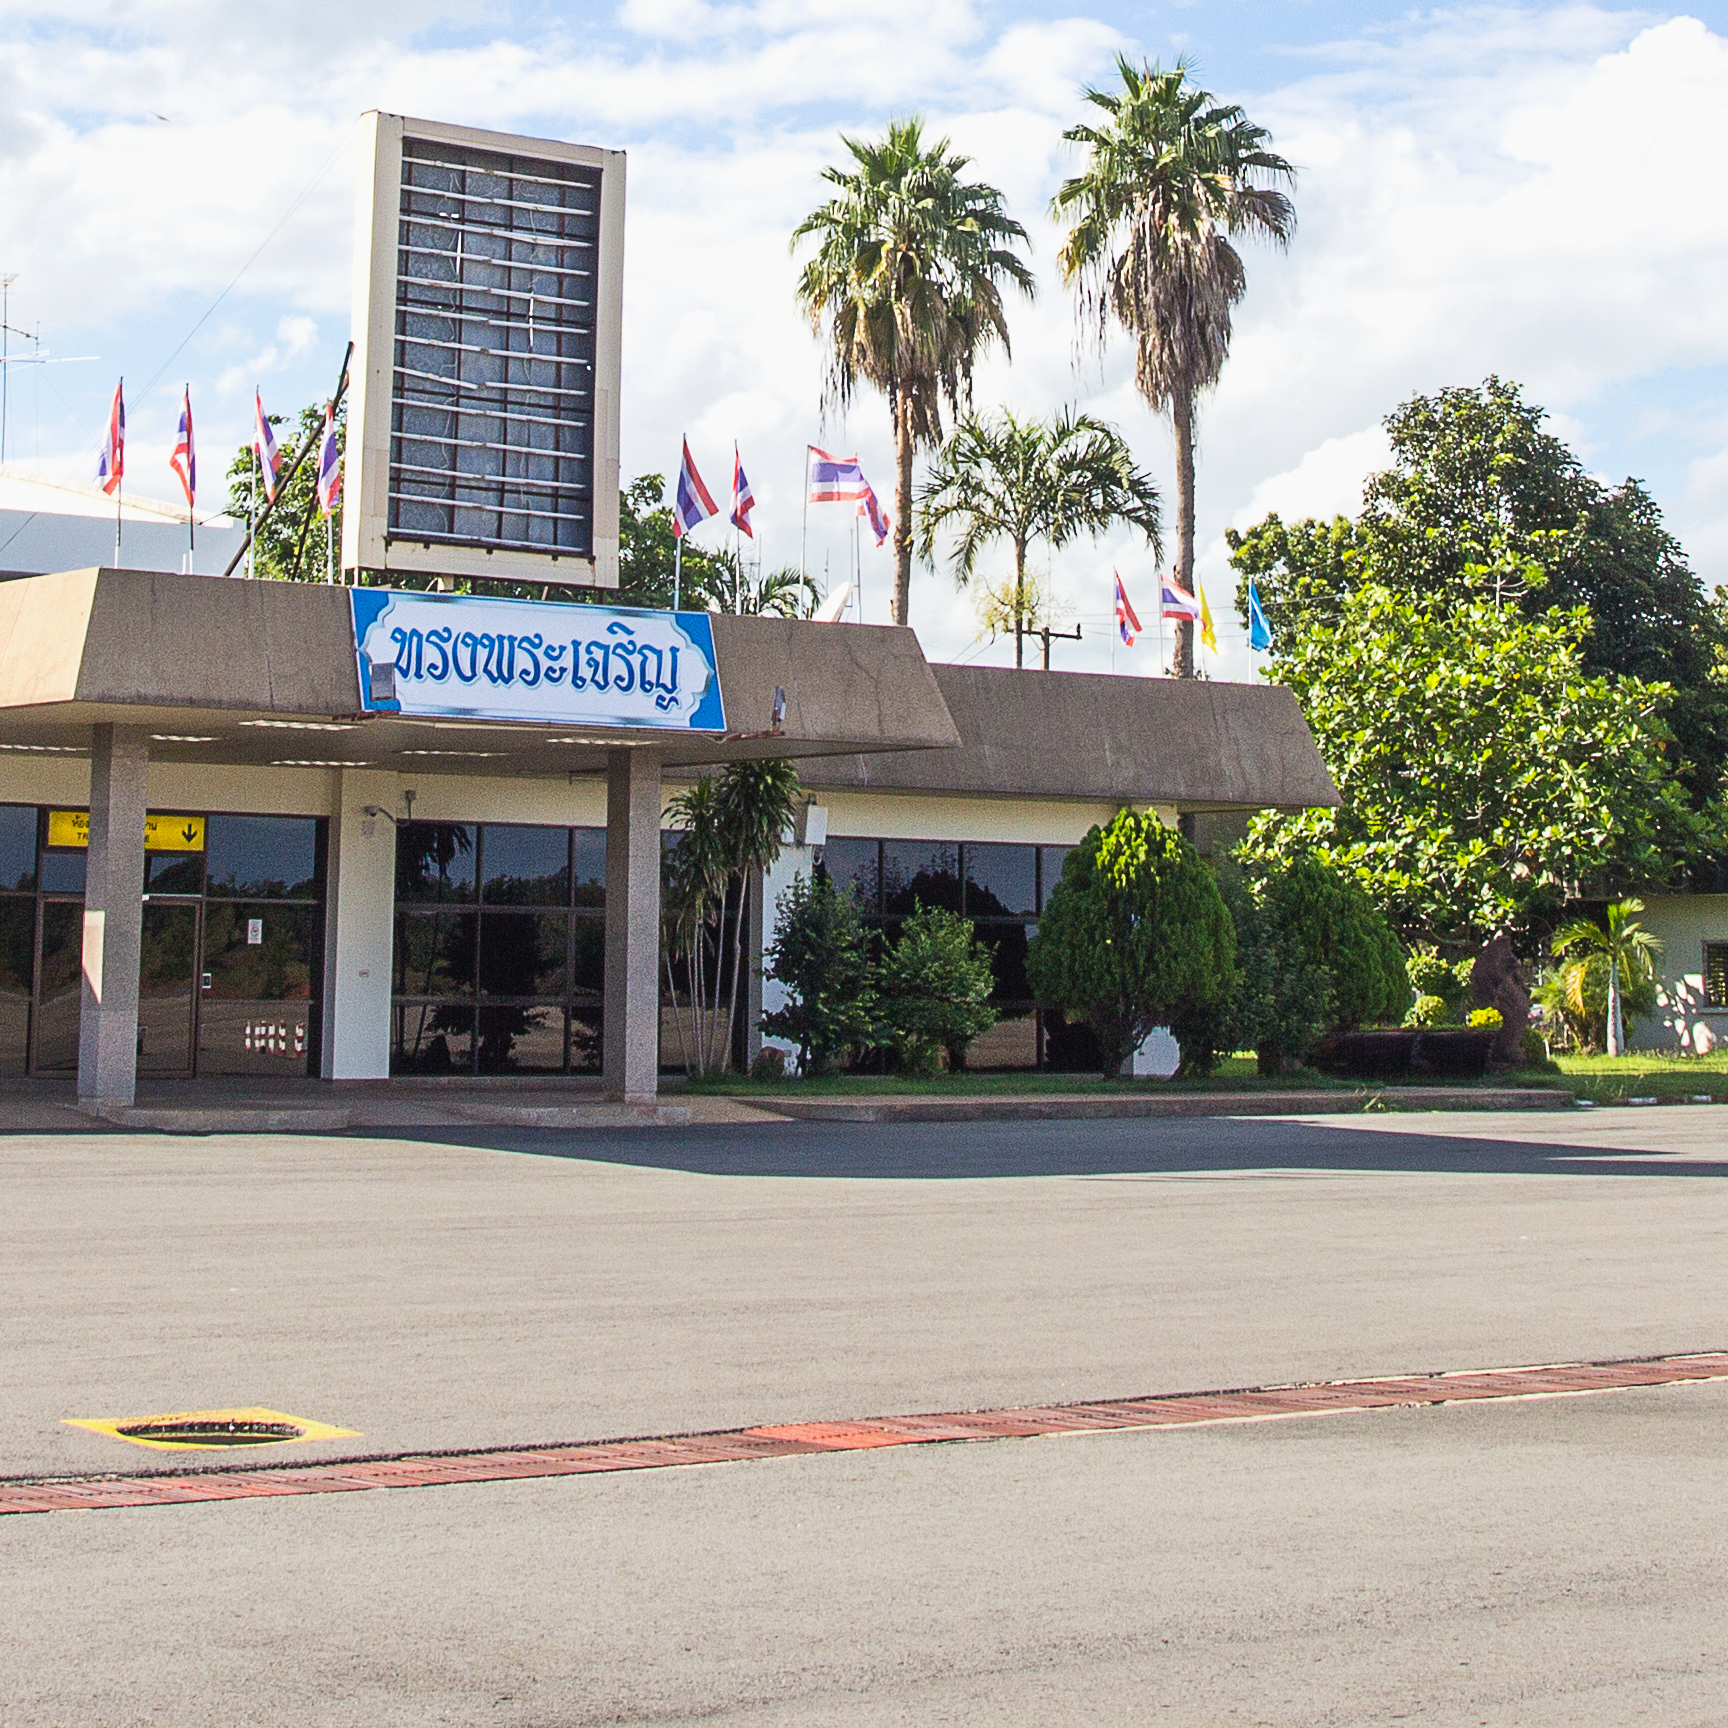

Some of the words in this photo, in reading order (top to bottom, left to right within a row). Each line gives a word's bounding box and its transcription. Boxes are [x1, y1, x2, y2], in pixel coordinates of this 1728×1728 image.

[390, 622, 680, 710] ทรงพระเจริญ
